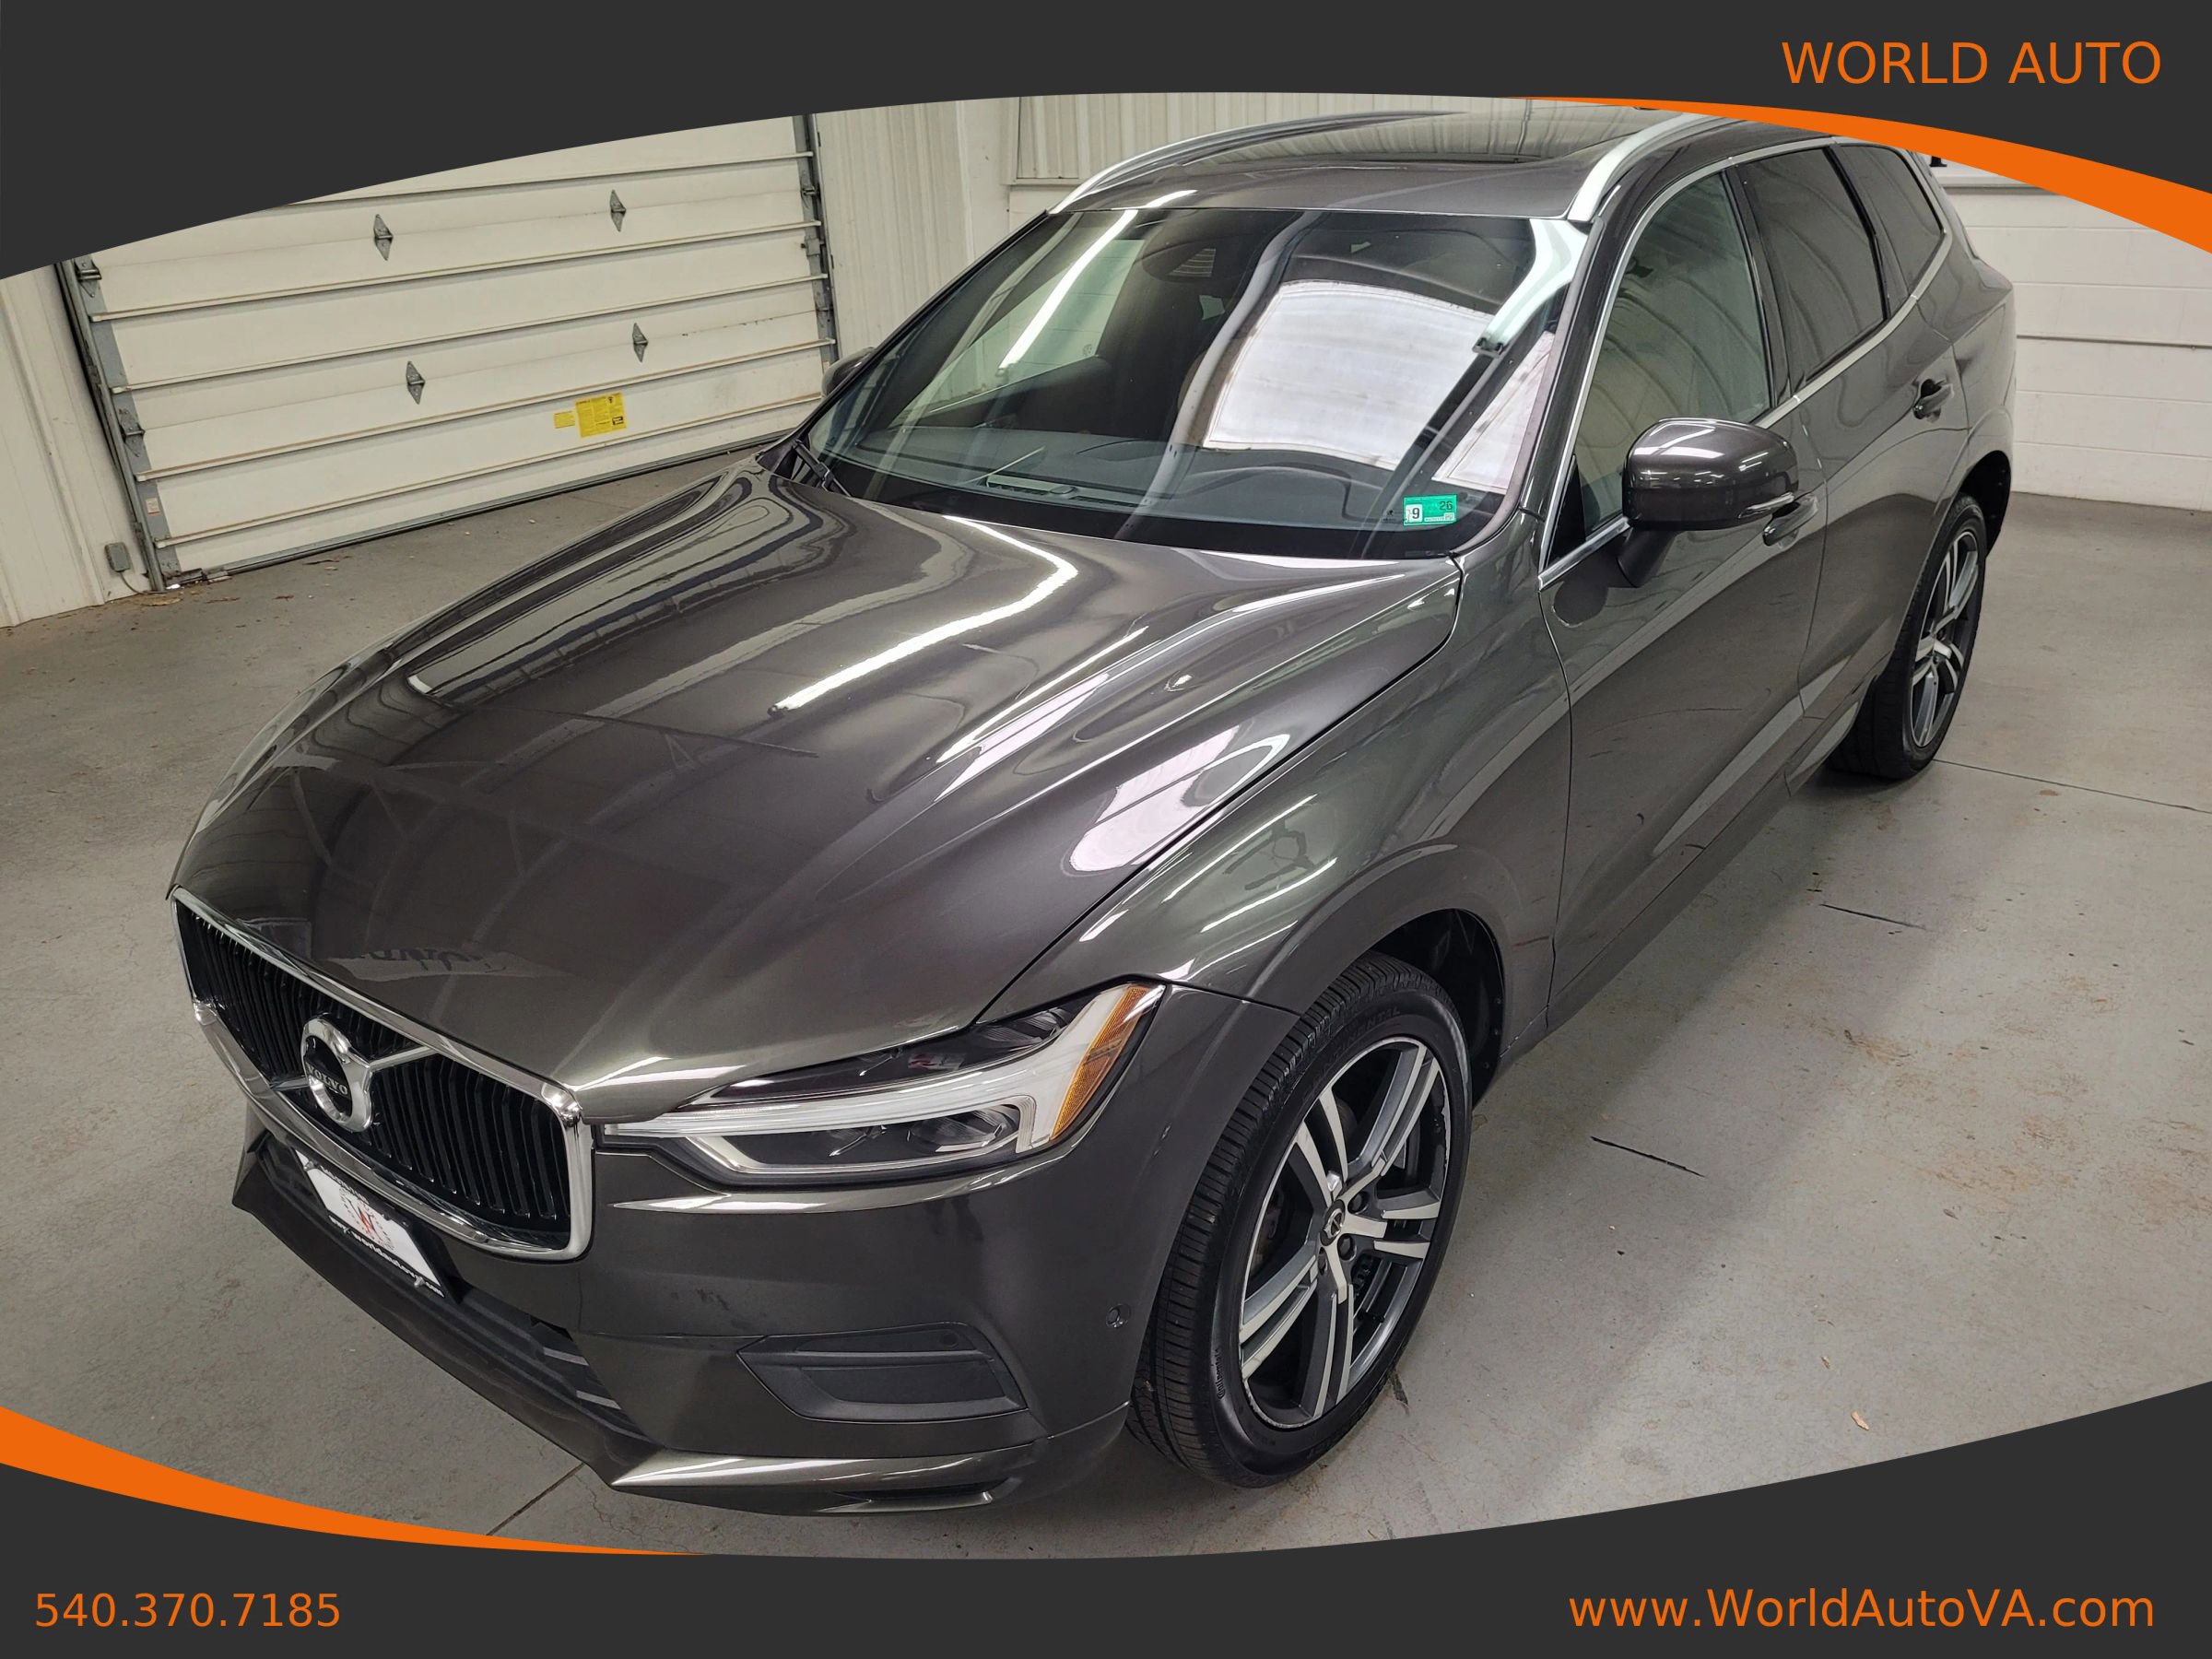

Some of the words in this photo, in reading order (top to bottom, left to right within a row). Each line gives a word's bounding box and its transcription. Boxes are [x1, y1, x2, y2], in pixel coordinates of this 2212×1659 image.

[1440, 500, 1453, 511] 26
[1411, 508, 1420, 519] 9
[305, 1061, 348, 1095] VOLVO
